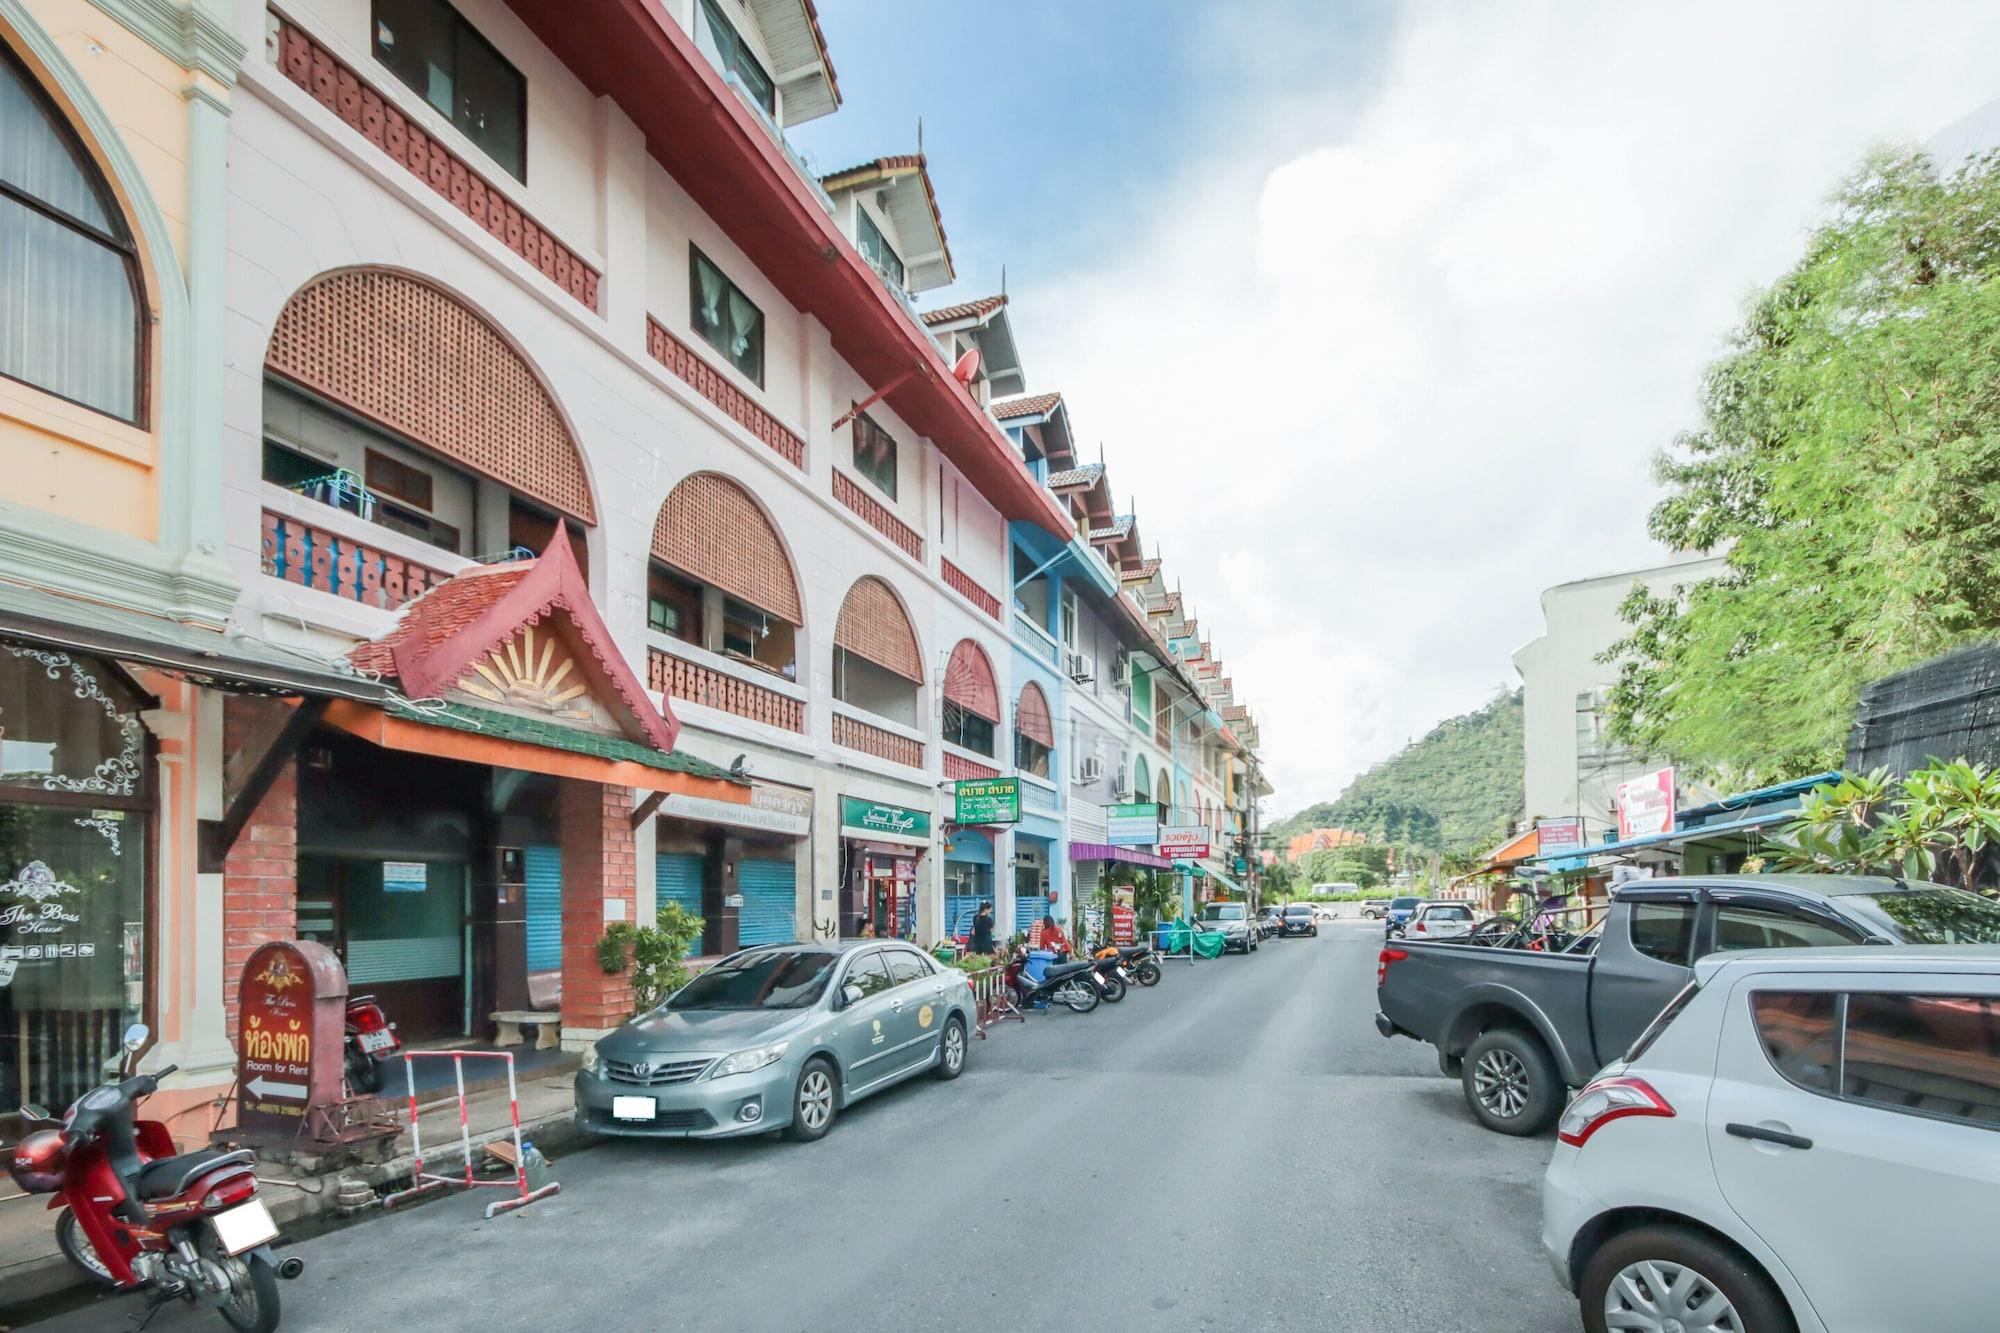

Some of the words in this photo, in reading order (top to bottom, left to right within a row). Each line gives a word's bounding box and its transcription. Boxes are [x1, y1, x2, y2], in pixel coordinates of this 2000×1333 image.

[0, 904, 34, 926] The
[40, 903, 80, 922] Boss
[18, 921, 64, 934] House
[245, 1014, 310, 1063] ห้องพัก
[246, 1060, 272, 1072] Room
[275, 1062, 286, 1073] for
[289, 1064, 309, 1075] Rent
